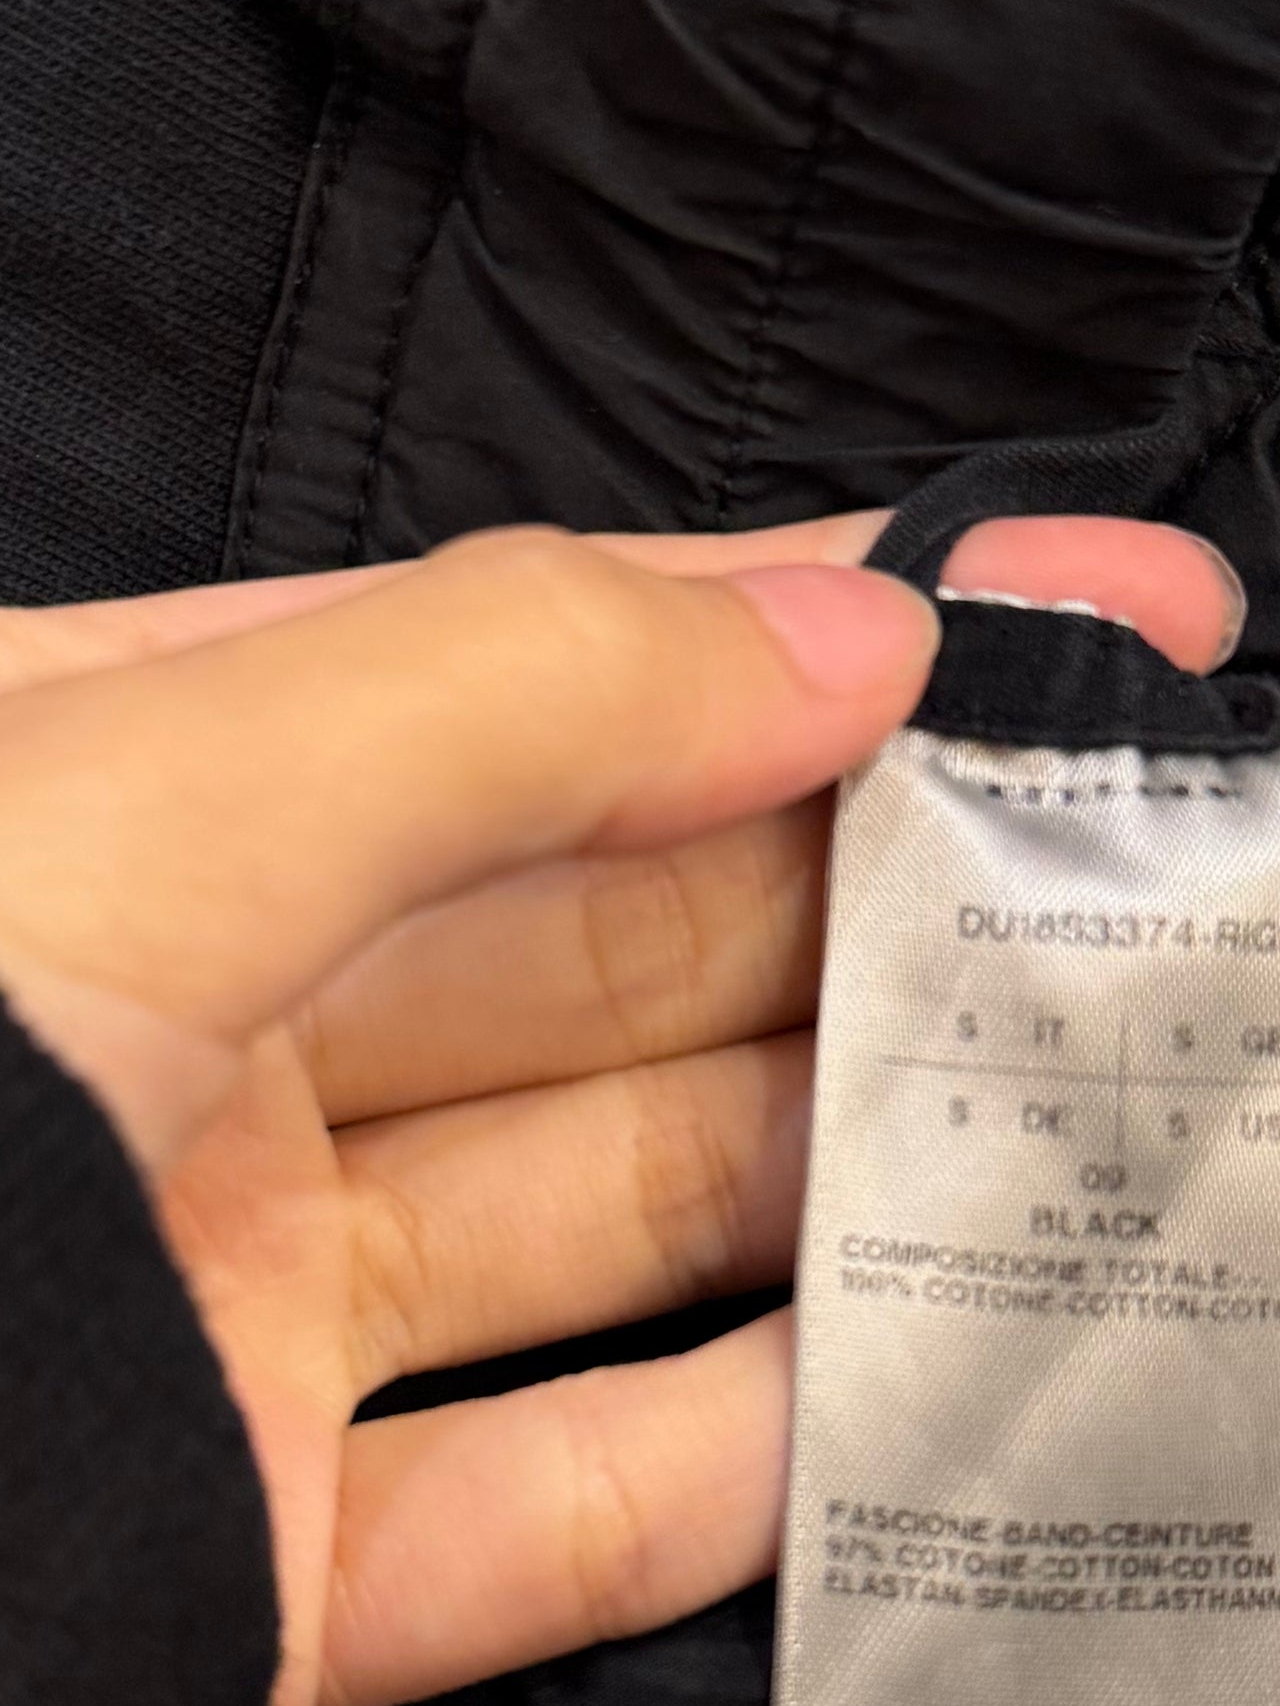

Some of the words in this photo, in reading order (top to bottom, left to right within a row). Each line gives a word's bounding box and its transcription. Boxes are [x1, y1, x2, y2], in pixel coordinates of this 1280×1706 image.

[957, 1010, 978, 1042] S
[1173, 1024, 1195, 1054] S
[948, 1095, 969, 1128] S
[1170, 1110, 1190, 1140] S
[1029, 1204, 1160, 1240] BLACK
[839, 1233, 1085, 1284] COMPOSIZIONE
